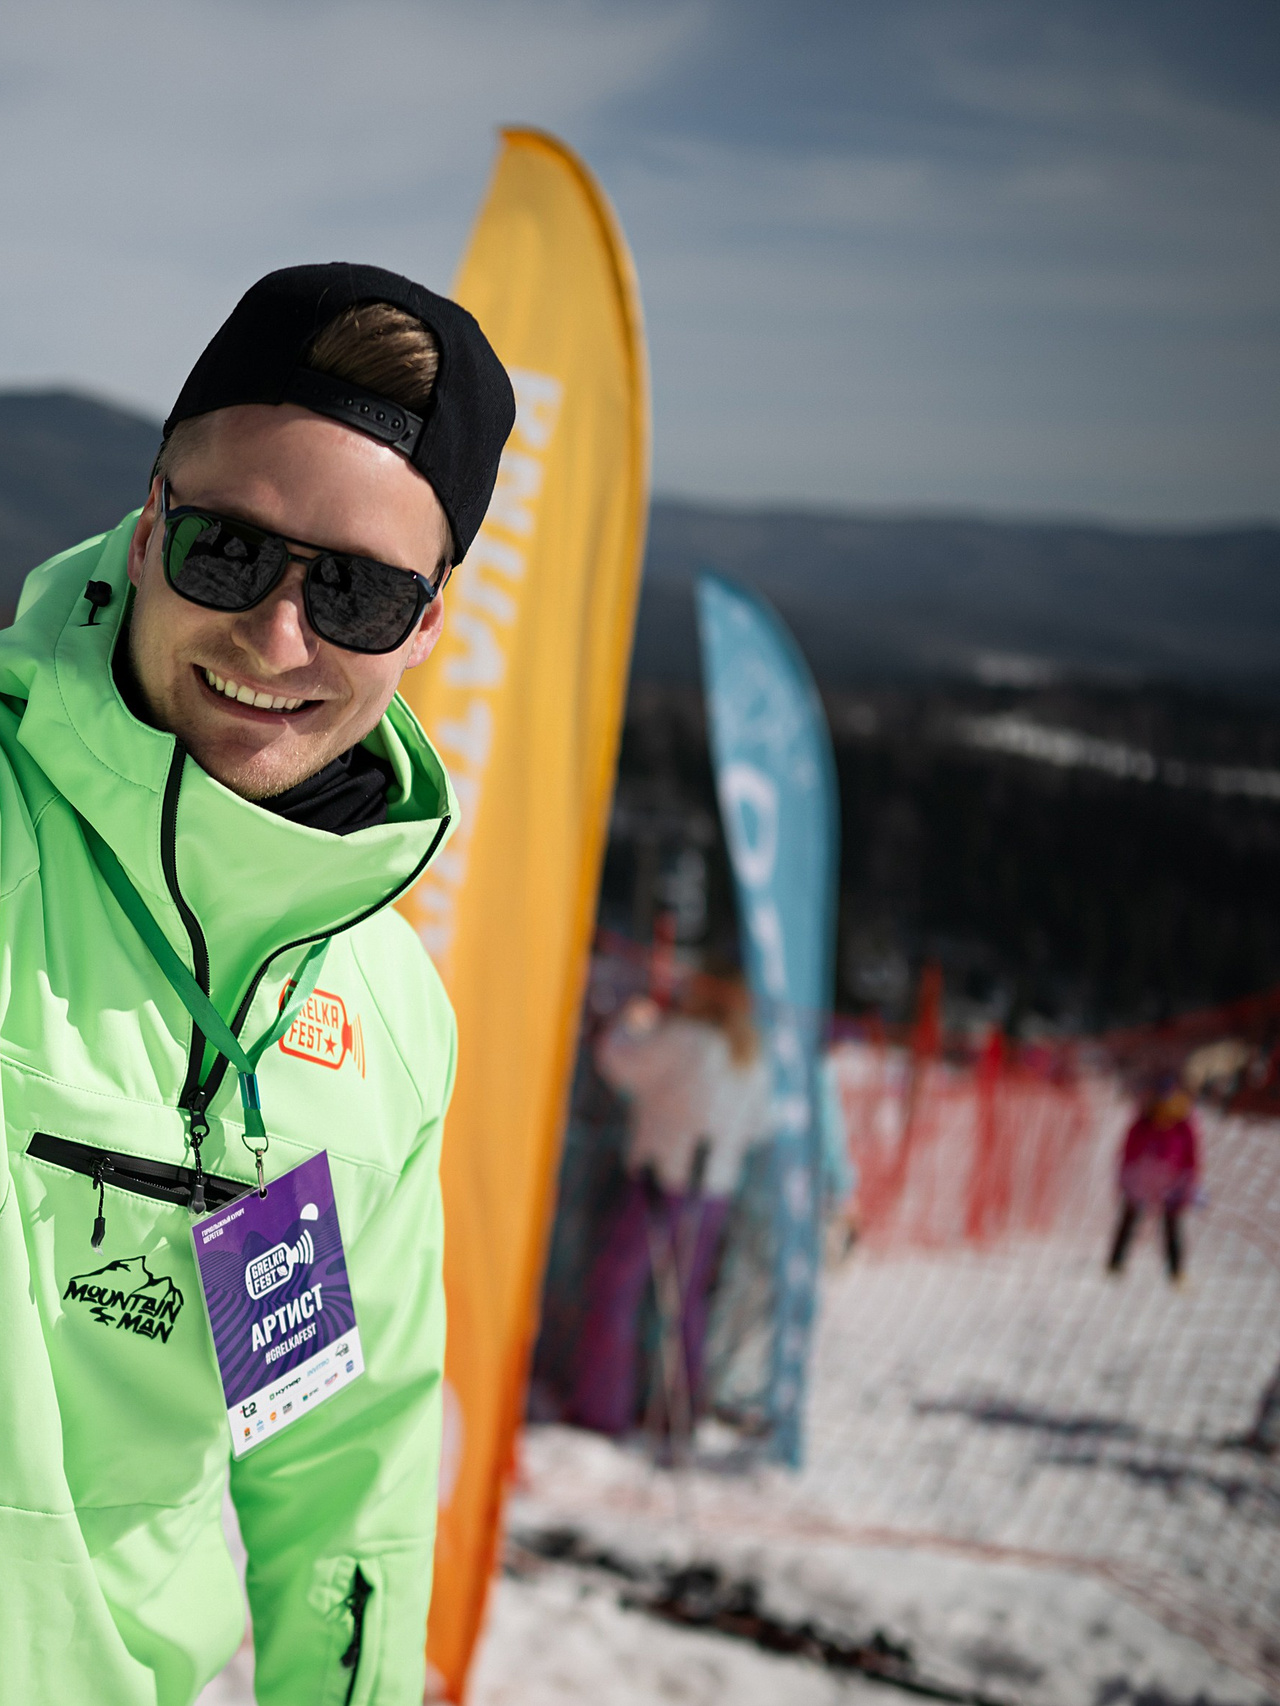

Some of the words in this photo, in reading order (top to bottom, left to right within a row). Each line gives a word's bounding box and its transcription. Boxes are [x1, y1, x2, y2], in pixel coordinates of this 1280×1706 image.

[288, 1019, 323, 1052] FEST
[251, 1248, 286, 1279] GRELKA
[253, 1268, 277, 1293] FEST
[251, 1282, 323, 1353] АРТИСТ
[264, 1321, 317, 1365] #GRELKAFEST
